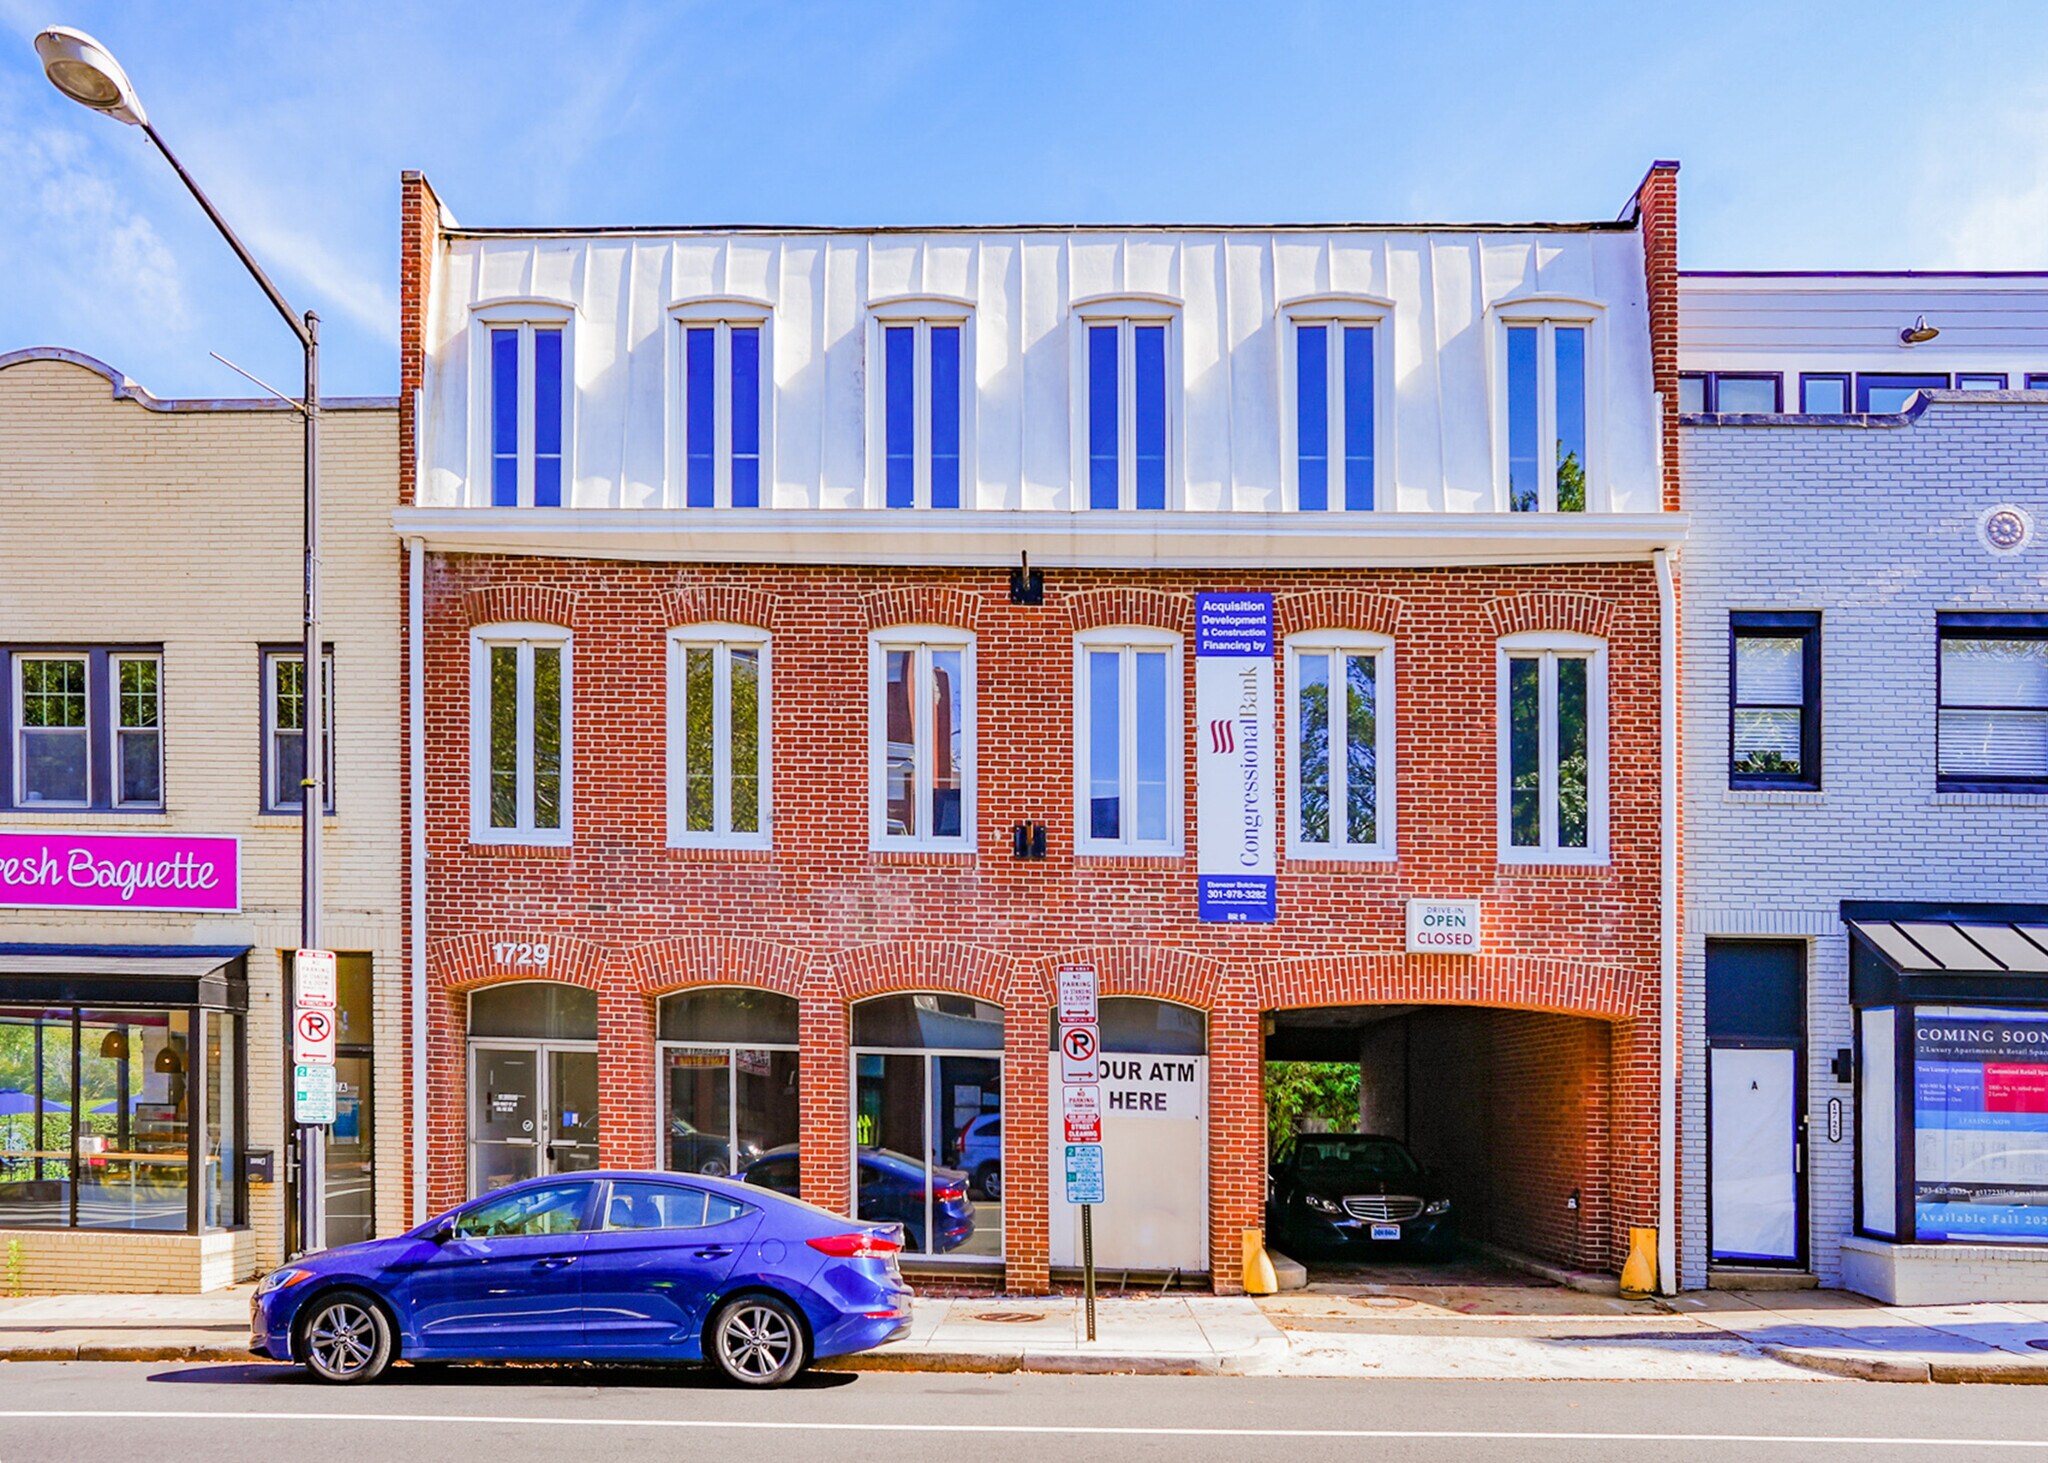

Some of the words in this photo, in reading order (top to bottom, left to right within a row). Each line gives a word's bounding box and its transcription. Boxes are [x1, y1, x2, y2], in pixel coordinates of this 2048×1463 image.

[1203, 601, 1265, 613] Acquisition
[1202, 615, 1267, 626] Development
[1202, 628, 1210, 636] &
[1211, 628, 1267, 636] Construction
[1203, 641, 1251, 652] Financing
[1253, 641, 1266, 652] by
[67, 848, 219, 901] Baguette
[1427, 906, 1464, 914] DRIVE-IN
[1424, 914, 1466, 927] OPEN
[1417, 932, 1473, 945] CLOSED
[493, 942, 550, 966] 1729
[1917, 1028, 1994, 1042] COMING
[1926, 1046, 1951, 1055] Luxury
[1954, 1047, 1996, 1055] Apartments
[1149, 1062, 1194, 1082] ATM
[1752, 1081, 1758, 1090] A
[1109, 1091, 1167, 1111] HERE
[1920, 1211, 1986, 1224] Available
[1992, 1214, 2018, 1224] Fall
